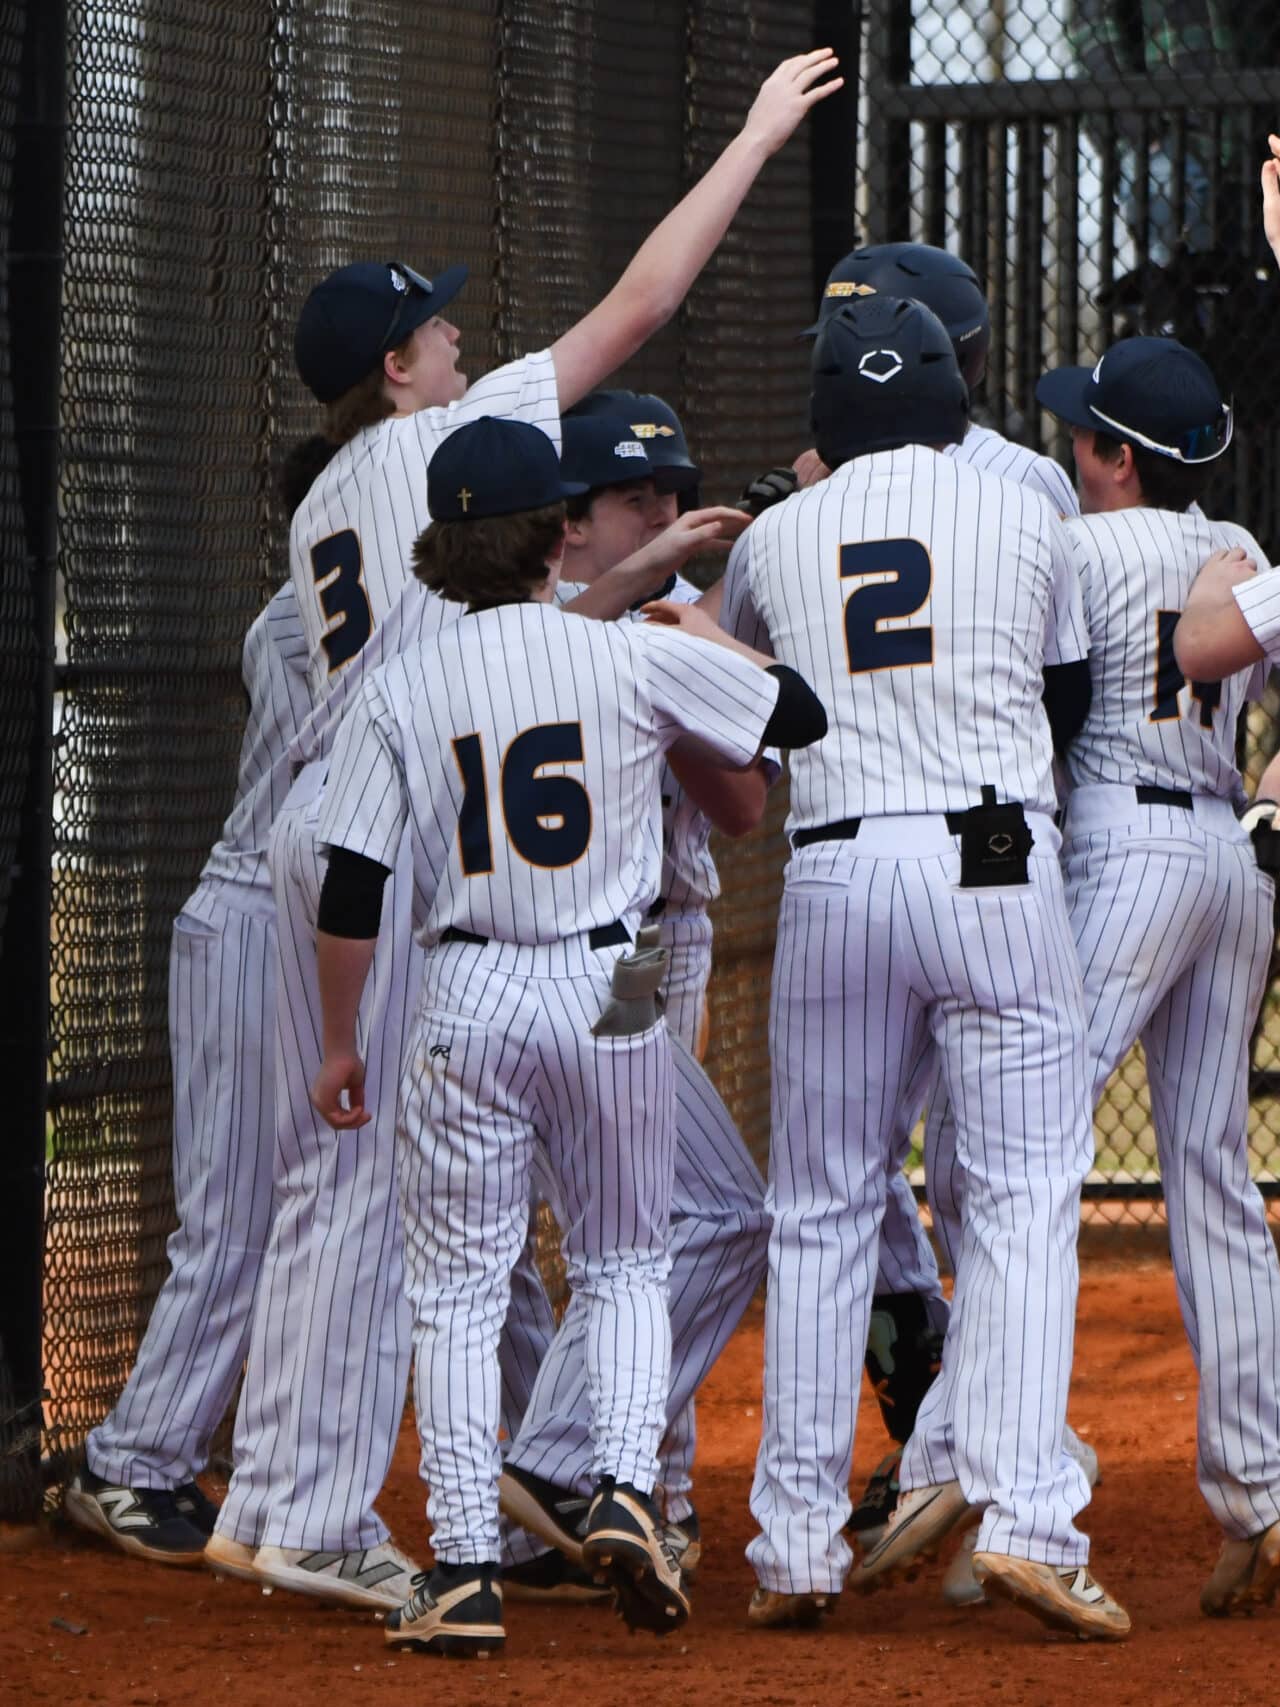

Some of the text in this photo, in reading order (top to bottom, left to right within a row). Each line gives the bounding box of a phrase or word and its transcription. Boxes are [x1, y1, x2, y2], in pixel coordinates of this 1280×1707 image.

[310, 528, 375, 675] 3
[837, 537, 934, 676] 2
[450, 720, 594, 879] 16
